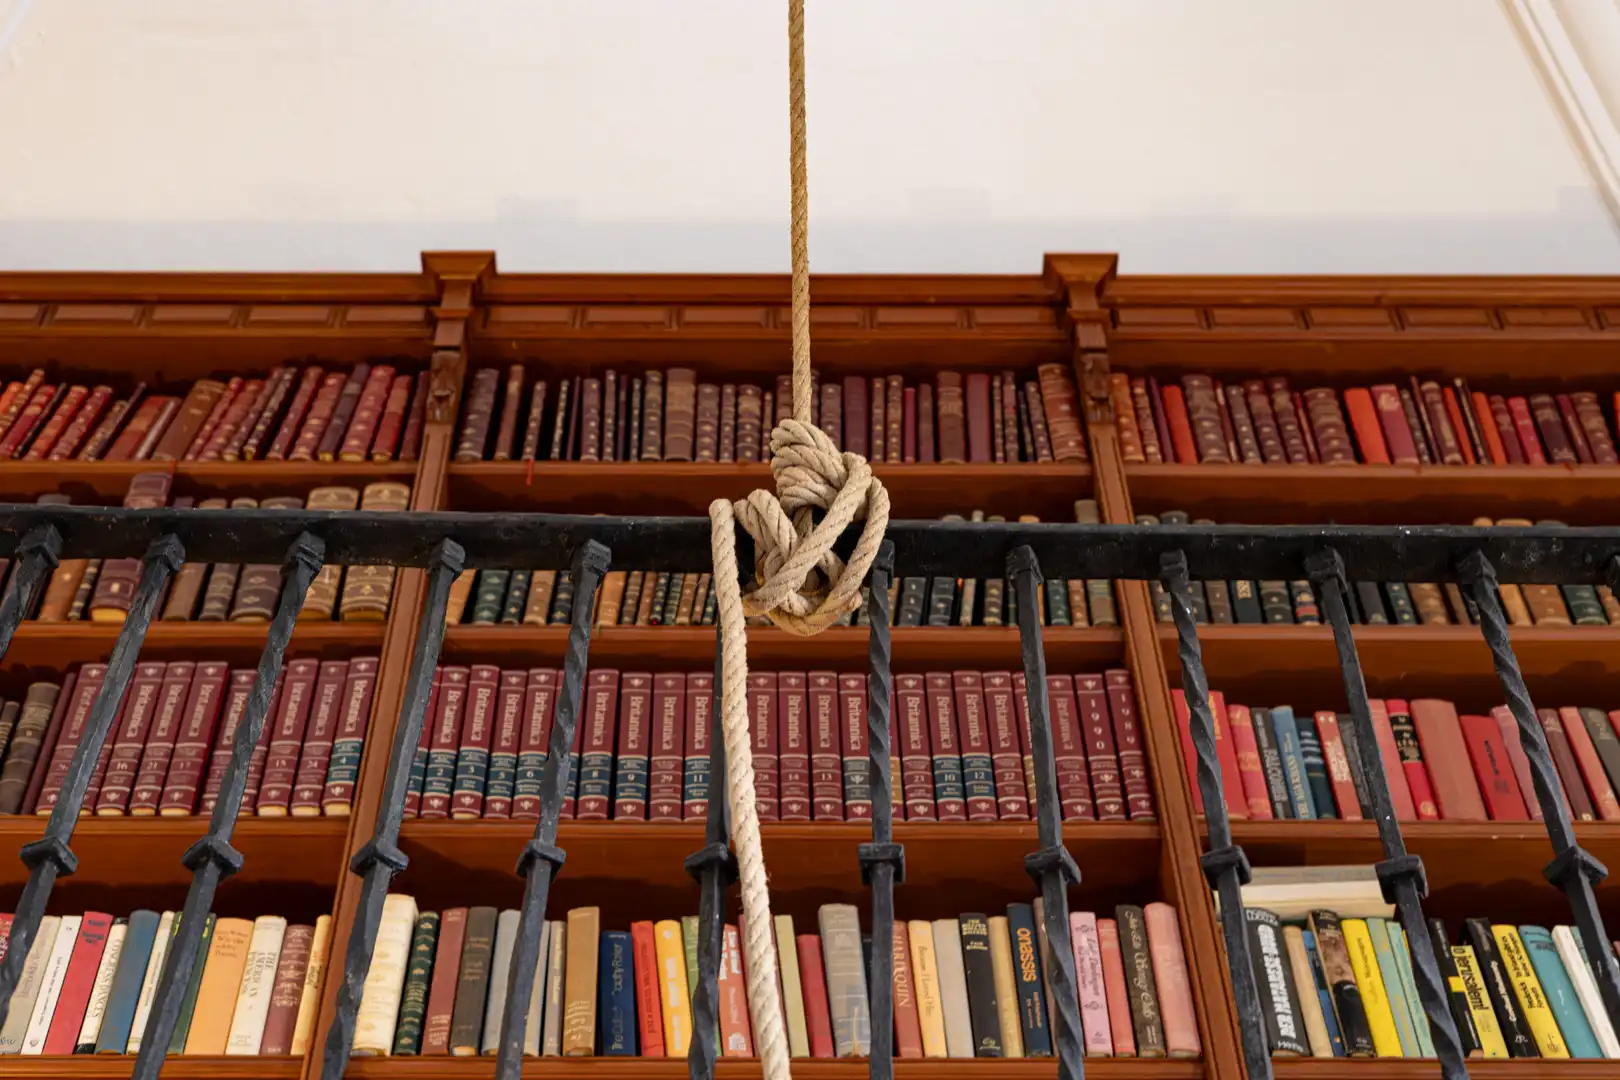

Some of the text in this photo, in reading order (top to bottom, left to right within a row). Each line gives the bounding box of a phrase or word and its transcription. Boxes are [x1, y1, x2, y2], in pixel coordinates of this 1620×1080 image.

[126, 685, 154, 738] Britannica
[156, 684, 183, 737] Britannica
[188, 684, 214, 737] Britannica
[281, 682, 306, 736] Britannica
[315, 684, 337, 736] Britannica
[344, 680, 368, 732] Britannica
[440, 690, 462, 743] Britannica
[470, 688, 491, 741] Britannica
[500, 694, 520, 747] Britannica
[529, 691, 549, 746] Britannica
[592, 692, 610, 746] Britannica
[628, 696, 644, 749] Britannica
[662, 696, 677, 750] Britannica
[694, 696, 709, 750] Britannica
[757, 695, 770, 748] Britannica
[788, 695, 802, 748] Britannica
[818, 695, 832, 748] Britannica
[848, 697, 863, 750] Britannica
[906, 696, 923, 749] Britannica
[936, 696, 953, 749] Britannica
[965, 693, 983, 746] Britannica
[994, 695, 1012, 748] Britannica
[1055, 698, 1074, 750] Britannica
[1017, 927, 1037, 982] onassis
